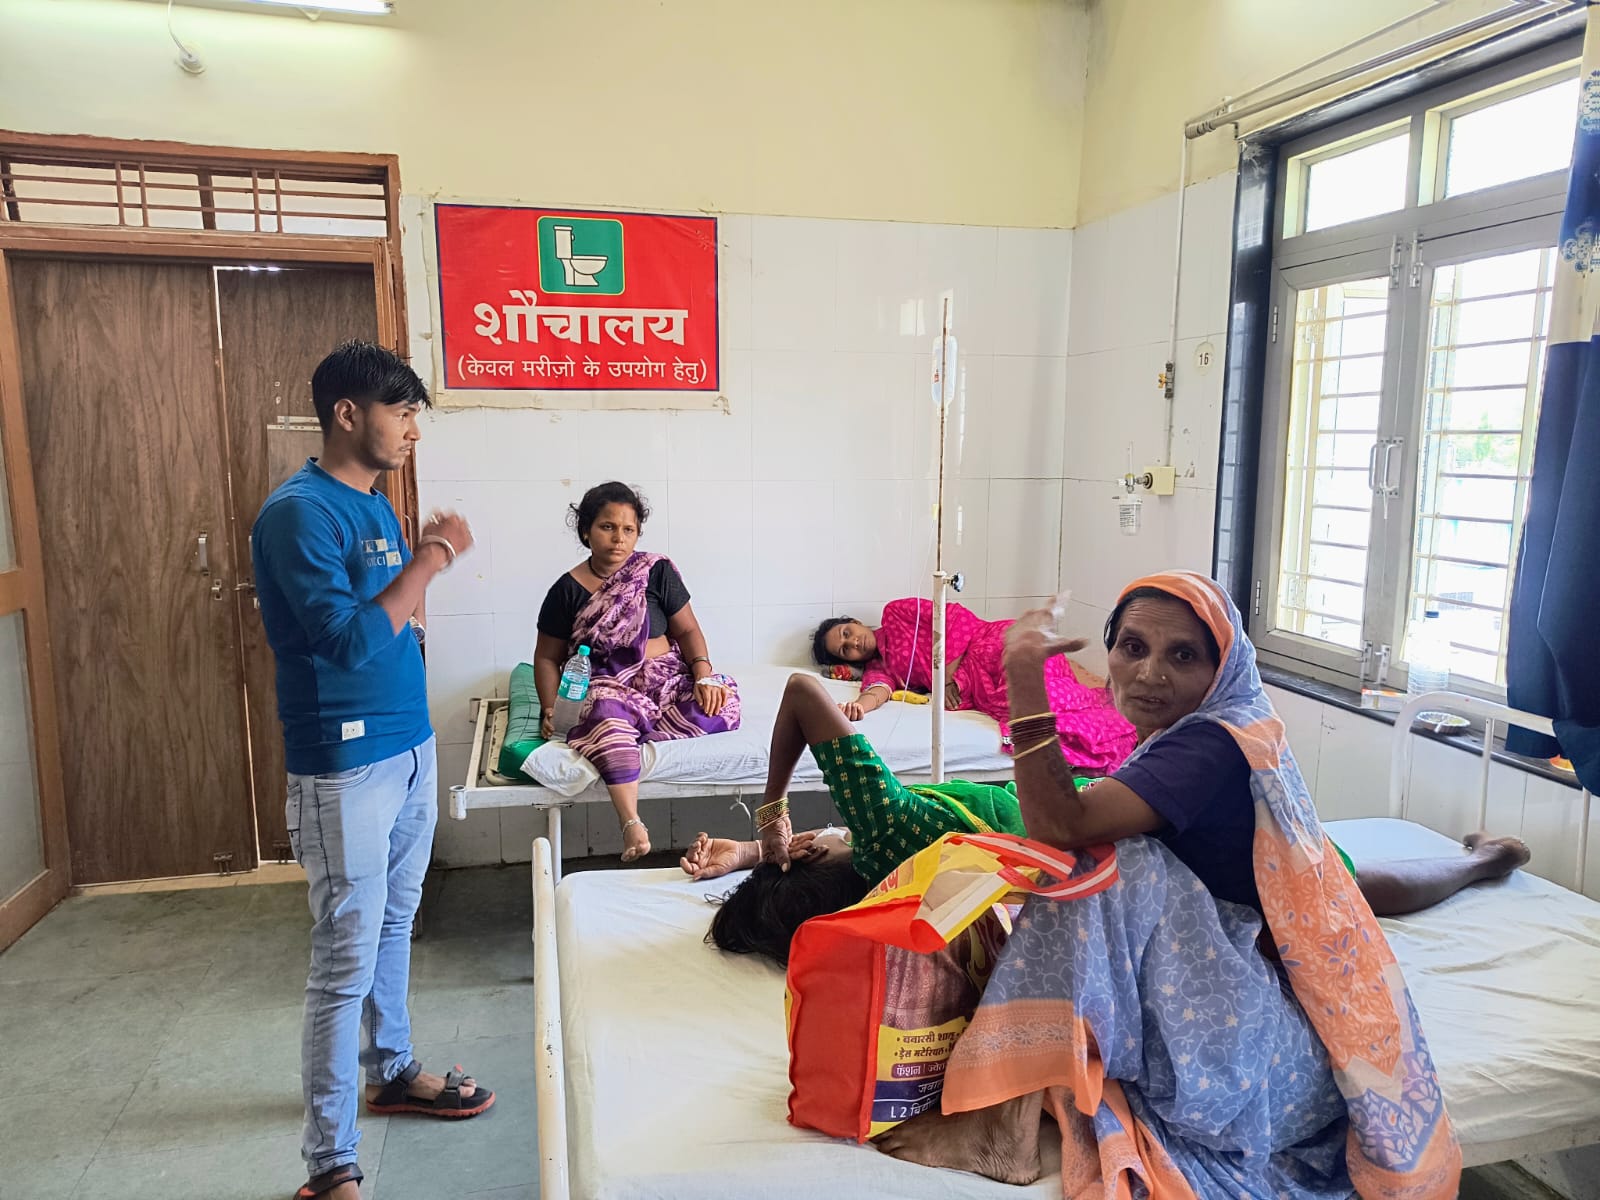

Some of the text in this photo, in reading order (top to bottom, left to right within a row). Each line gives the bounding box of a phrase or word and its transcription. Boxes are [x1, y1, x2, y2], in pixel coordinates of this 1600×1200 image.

[474, 290, 688, 346] शौचालय
[458, 353, 514, 381] (केवल
[582, 355, 600, 378] के
[608, 355, 666, 378] उपयोग
[672, 356, 707, 384] हेतु)
[1199, 352, 1209, 366] 16
[890, 1105, 897, 1119] L
[900, 1106, 908, 1118] 2
